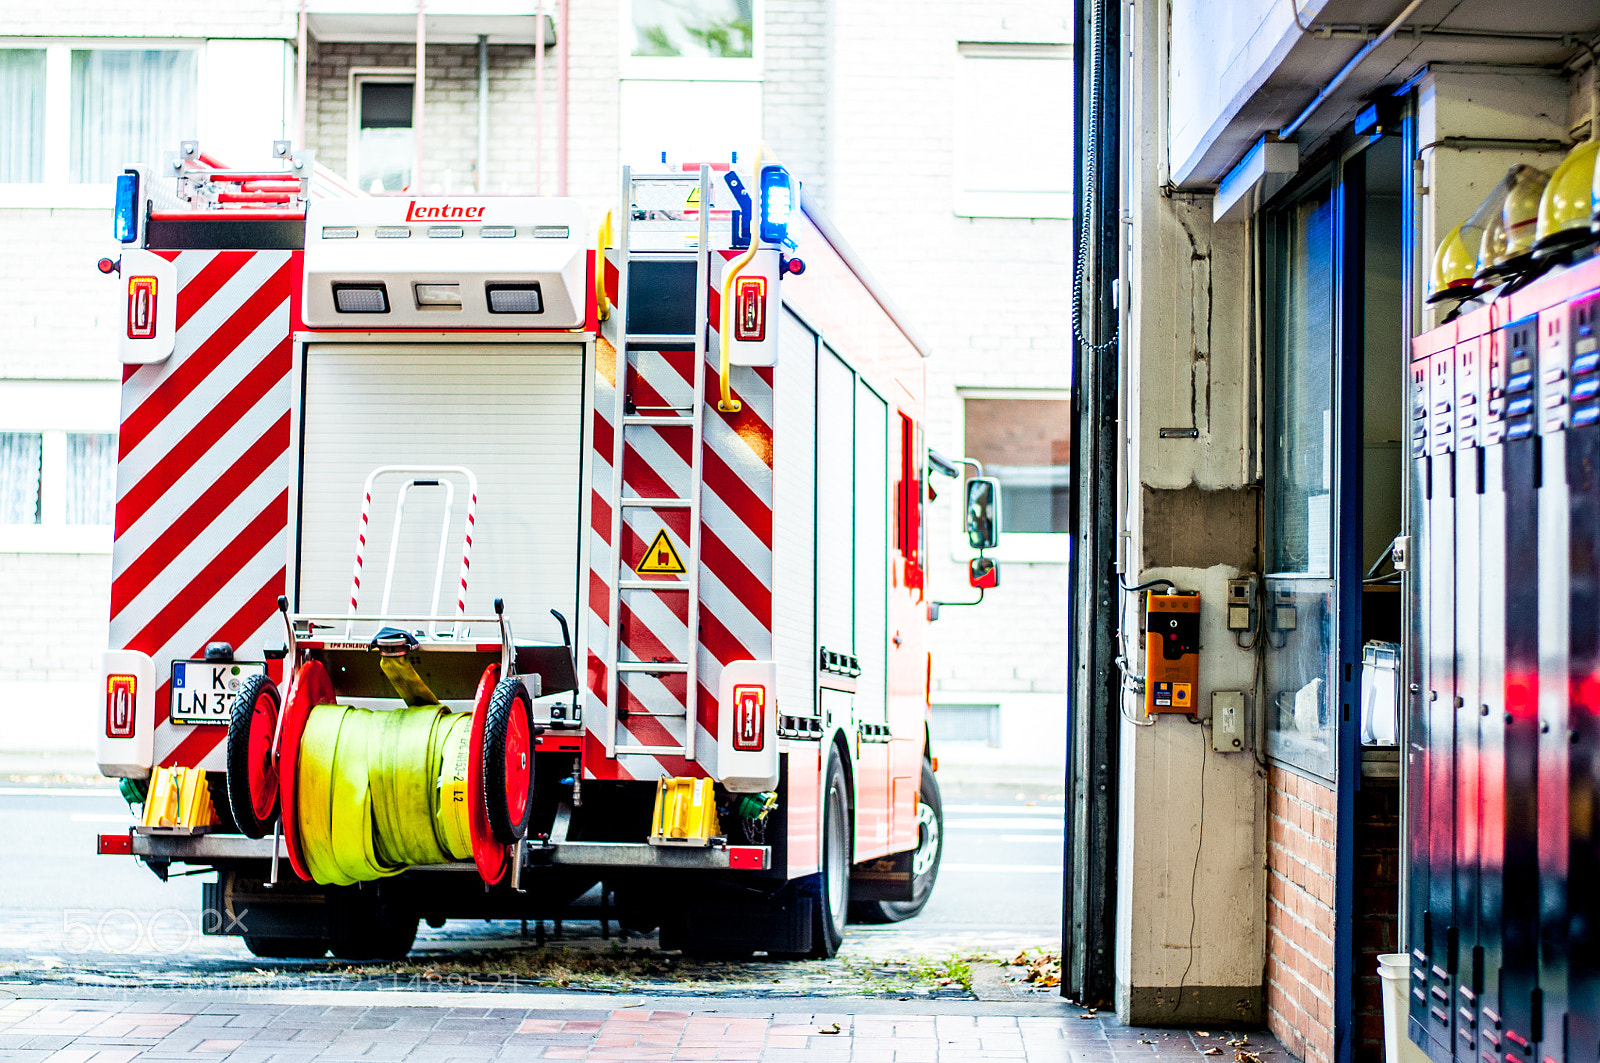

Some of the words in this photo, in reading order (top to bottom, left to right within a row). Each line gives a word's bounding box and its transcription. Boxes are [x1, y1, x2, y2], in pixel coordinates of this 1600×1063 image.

[405, 200, 486, 222] Lentner
[177, 678, 183, 686] D
[212, 667, 226, 690] K
[177, 692, 207, 714] LN
[453, 791, 464, 802] L2
